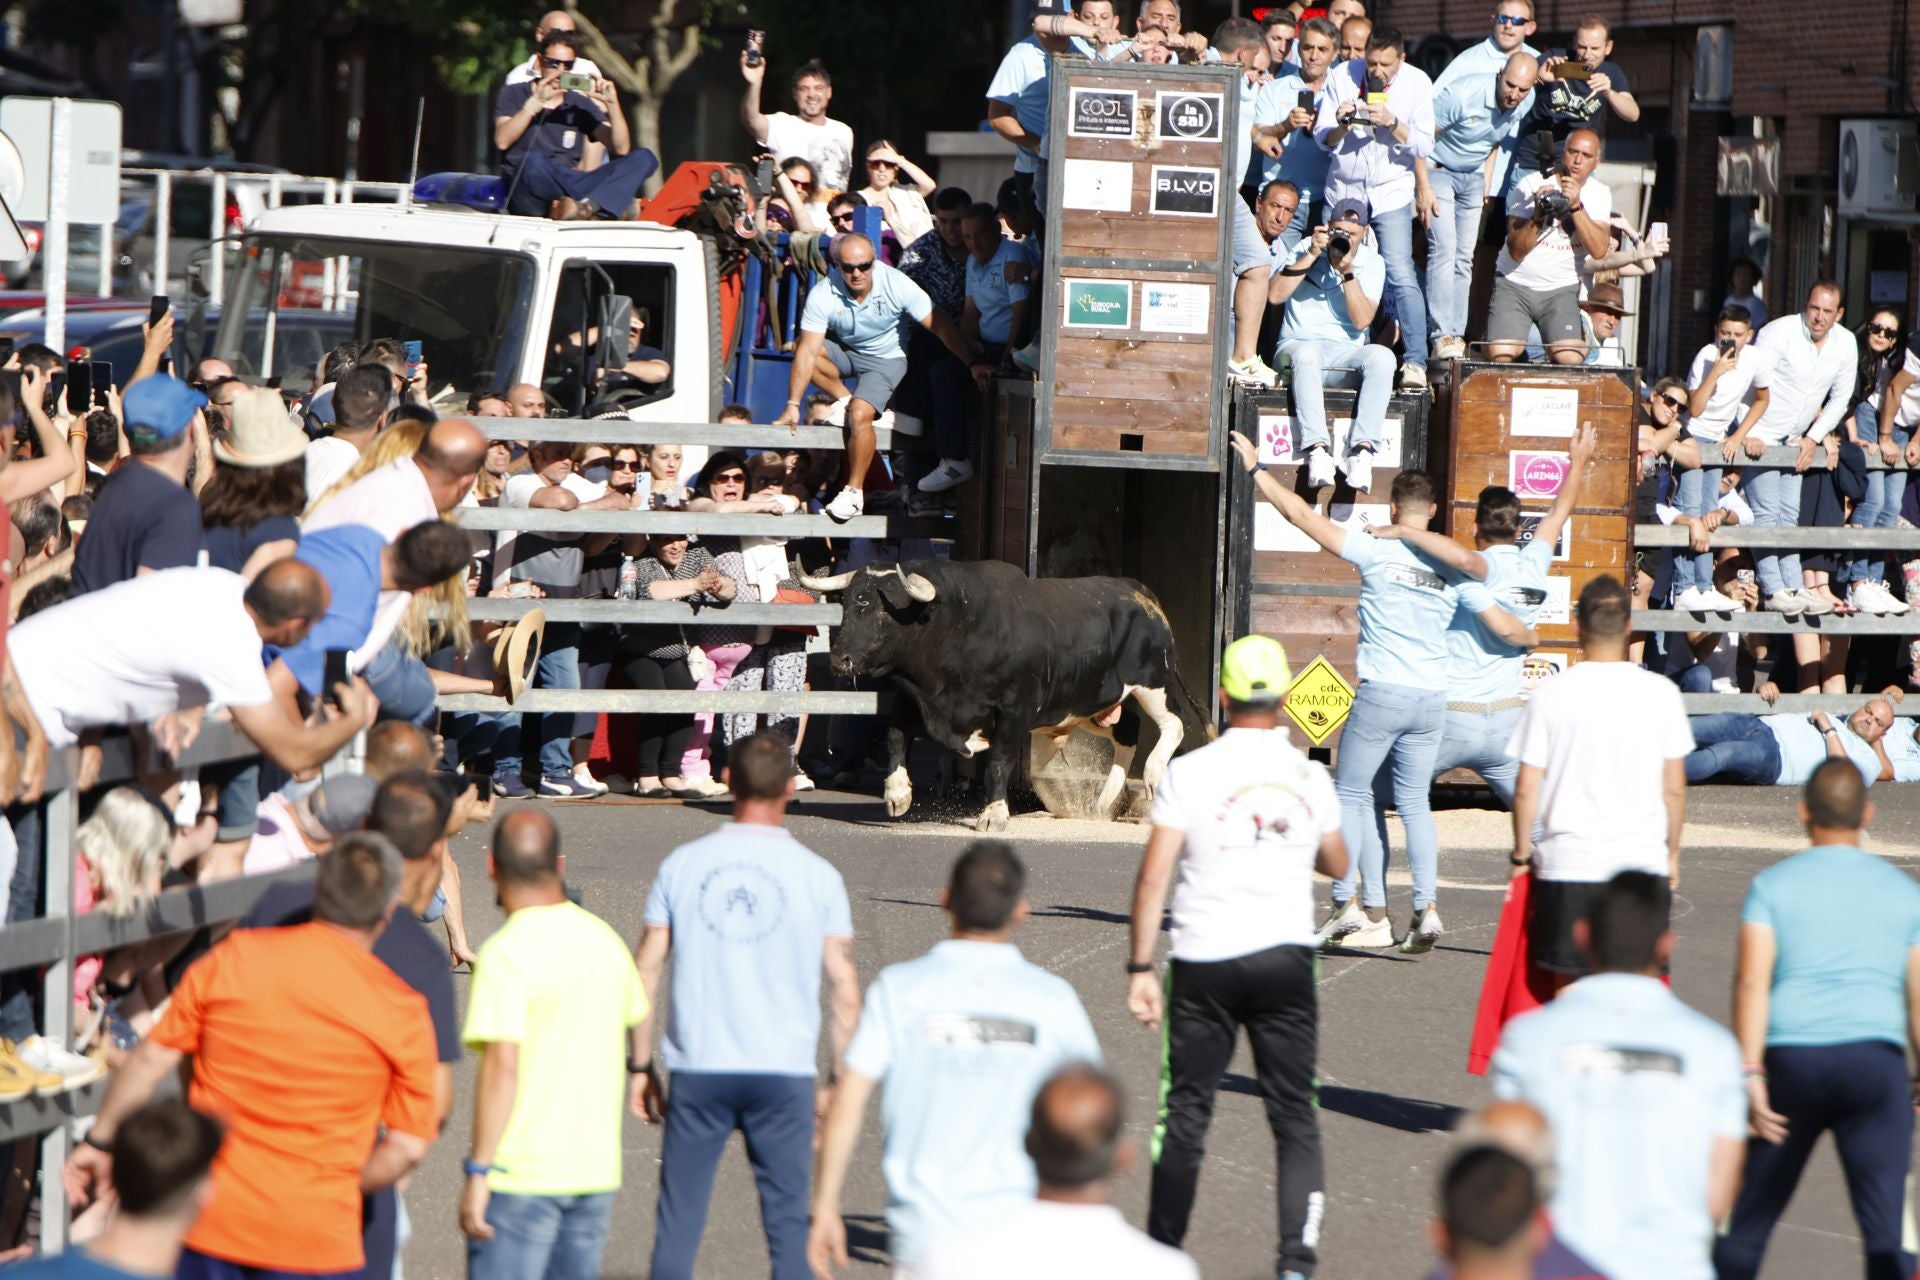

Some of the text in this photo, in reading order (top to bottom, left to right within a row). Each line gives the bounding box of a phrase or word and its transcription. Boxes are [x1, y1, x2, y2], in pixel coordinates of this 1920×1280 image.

[1081, 98, 1127, 116] COOL
[1184, 103, 1197, 115] la
[1177, 113, 1204, 128] sal
[1157, 178, 1214, 193] BLVD
[1320, 684, 1340, 692] cdc
[1289, 694, 1350, 707] RAMON
